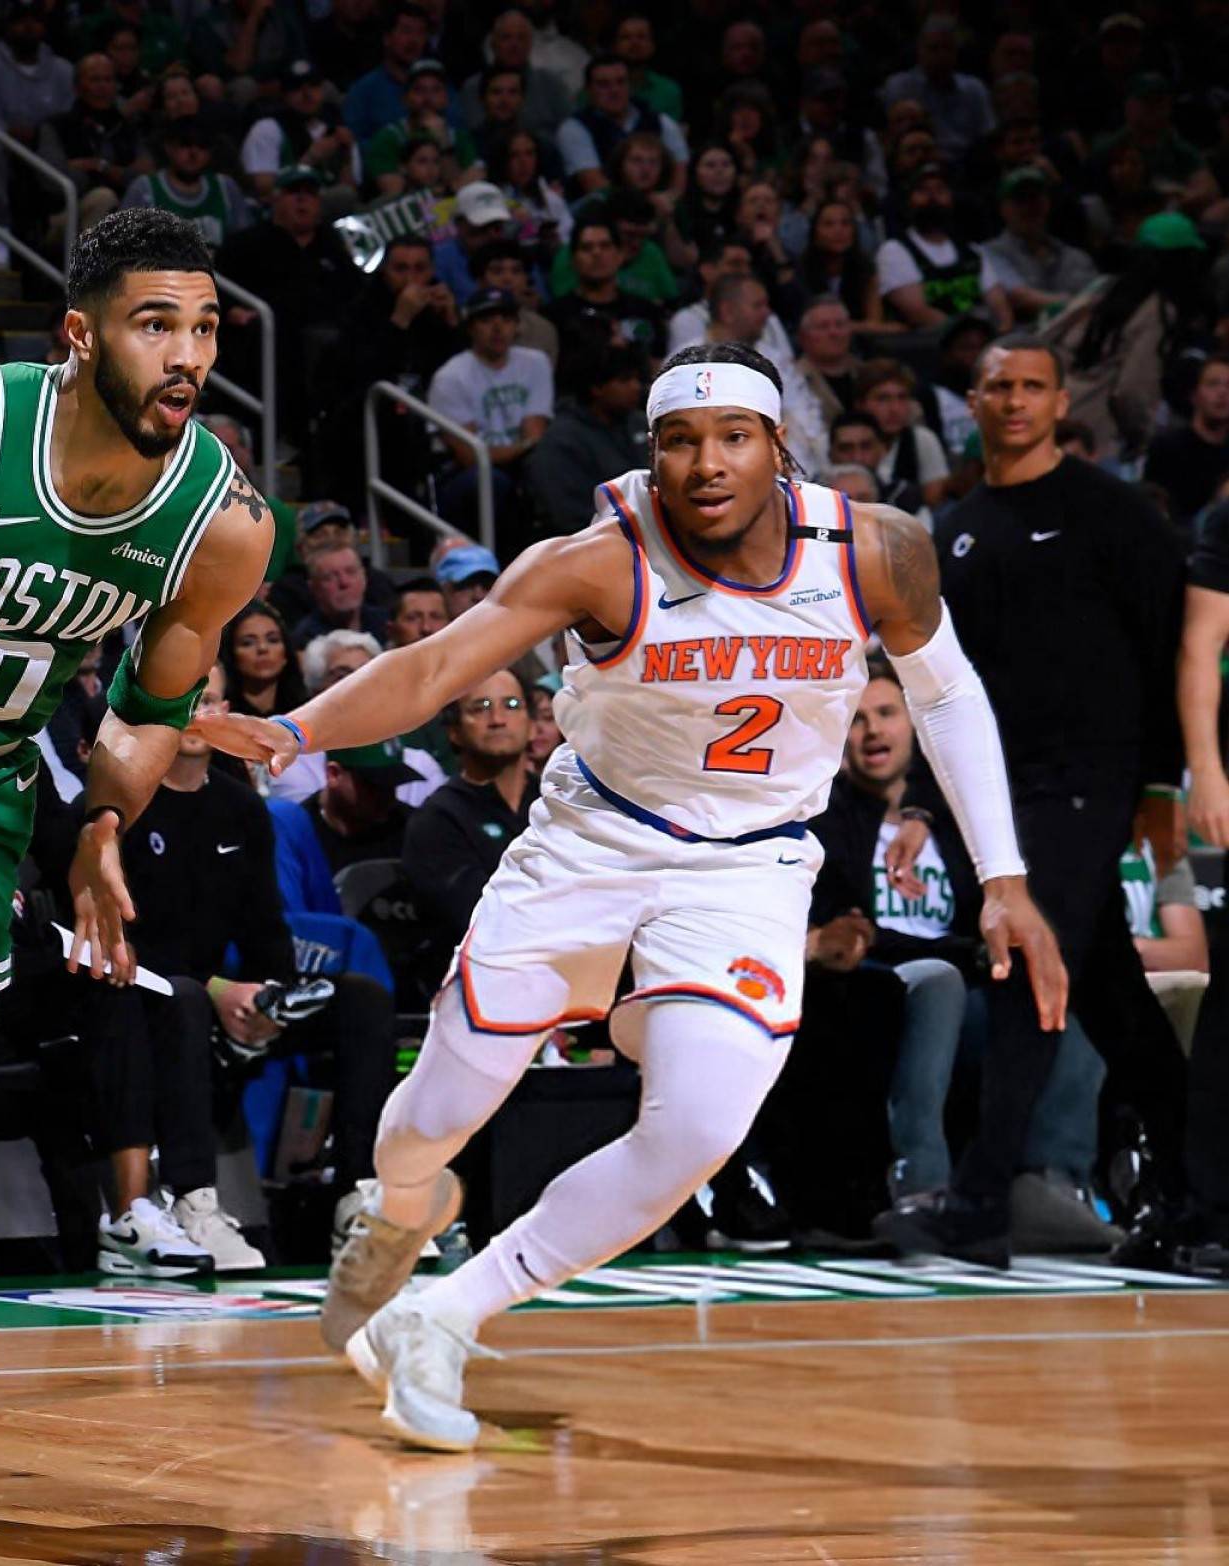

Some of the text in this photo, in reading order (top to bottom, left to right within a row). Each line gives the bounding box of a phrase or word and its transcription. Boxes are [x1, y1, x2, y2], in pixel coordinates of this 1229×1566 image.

[112, 541, 166, 569] Amica
[641, 635, 853, 683] NEW YORK
[703, 694, 784, 775] 2
